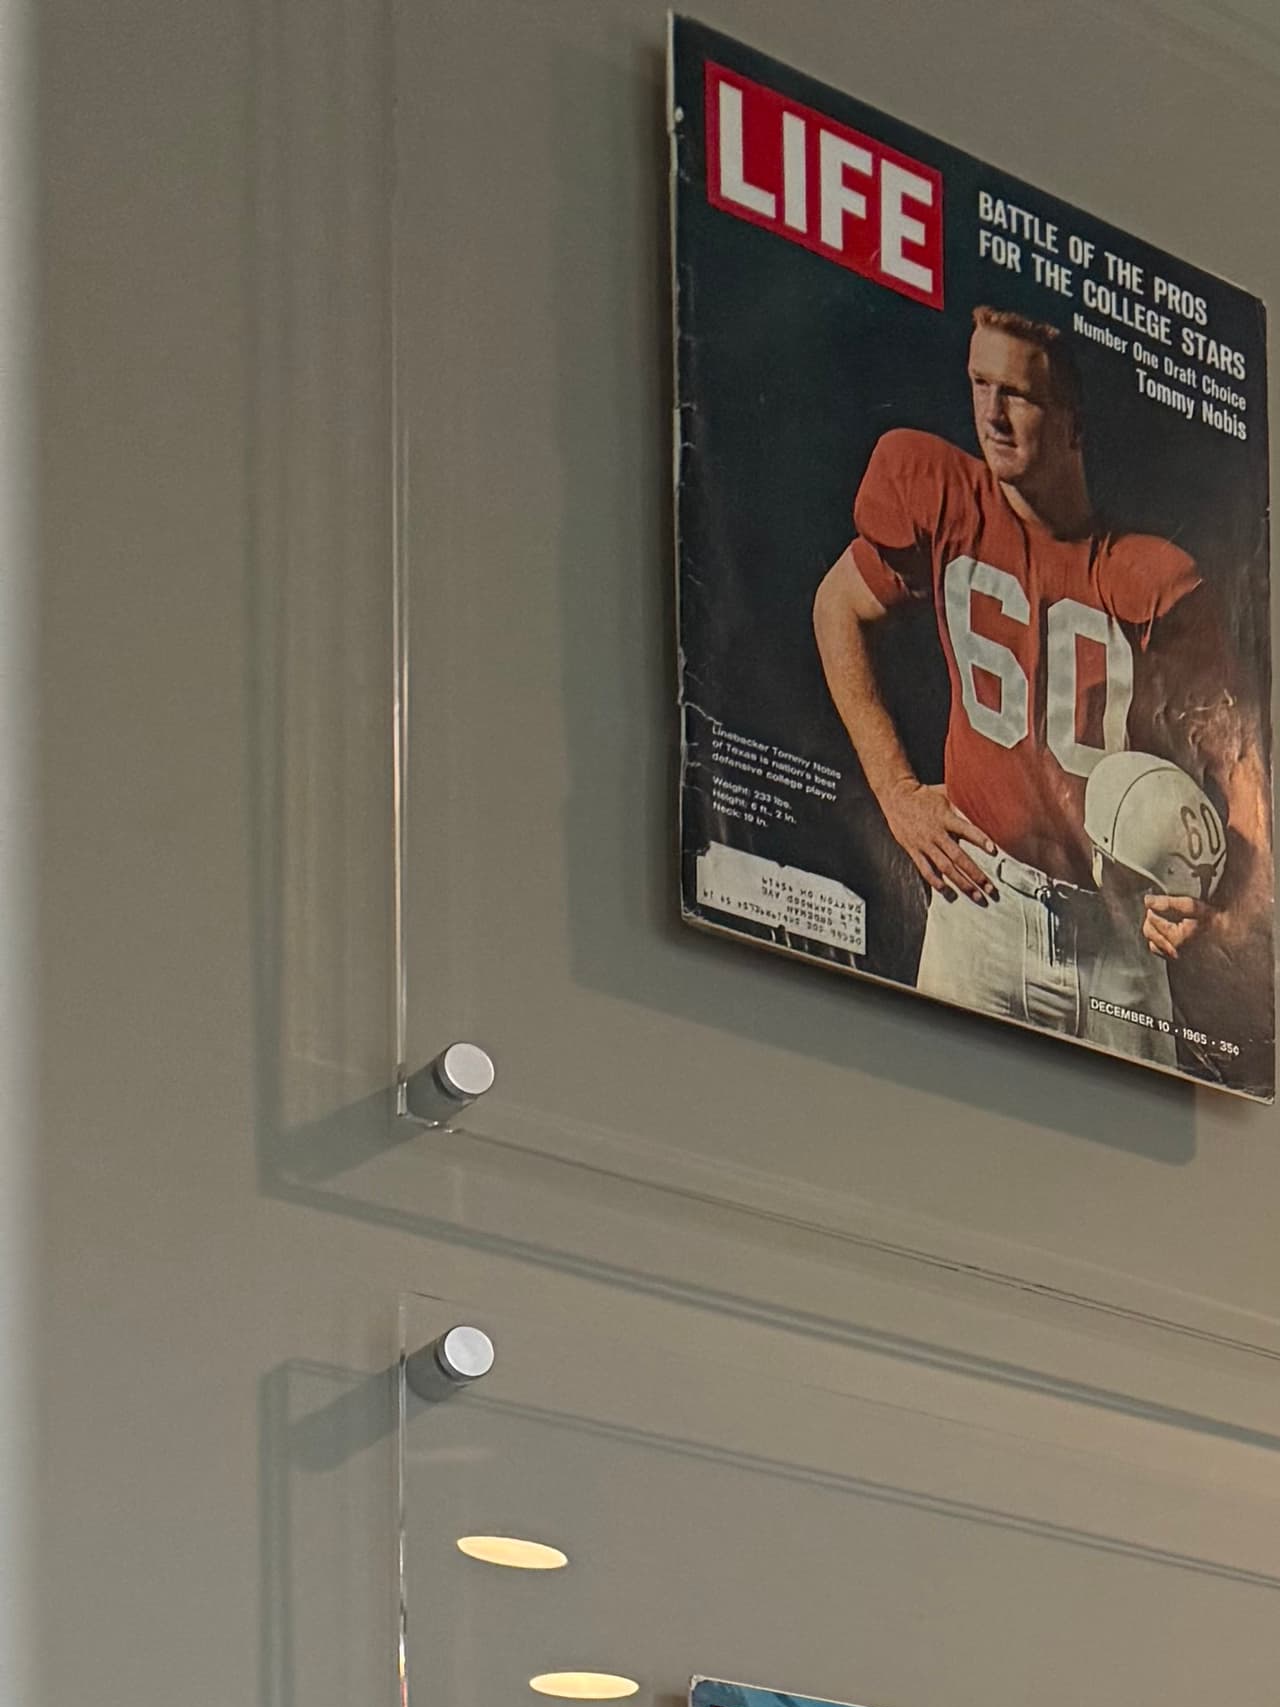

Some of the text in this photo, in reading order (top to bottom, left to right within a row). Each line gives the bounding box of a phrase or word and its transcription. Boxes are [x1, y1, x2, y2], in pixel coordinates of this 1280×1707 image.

[719, 80, 932, 294] LIFE
[979, 191, 1207, 325] BATTLE OF THE PROS
[979, 229, 1245, 380] FOR THE COLLEGE STARS
[1073, 312, 1246, 410] Number One Draft Choice
[1136, 368, 1247, 441] Tommy Nobis
[945, 555, 1133, 778] 60
[712, 725, 769, 752] Linebacker
[772, 747, 810, 768] Tommy
[712, 753, 837, 802] defensive college player
[726, 743, 756, 761] Texas
[760, 756, 769, 765] is
[814, 773, 836, 789] best
[1181, 803, 1220, 861] 60
[1091, 998, 1153, 1029] DECEMBER
[1158, 1020, 1170, 1032] 10
[1183, 1028, 1207, 1045] 1965
